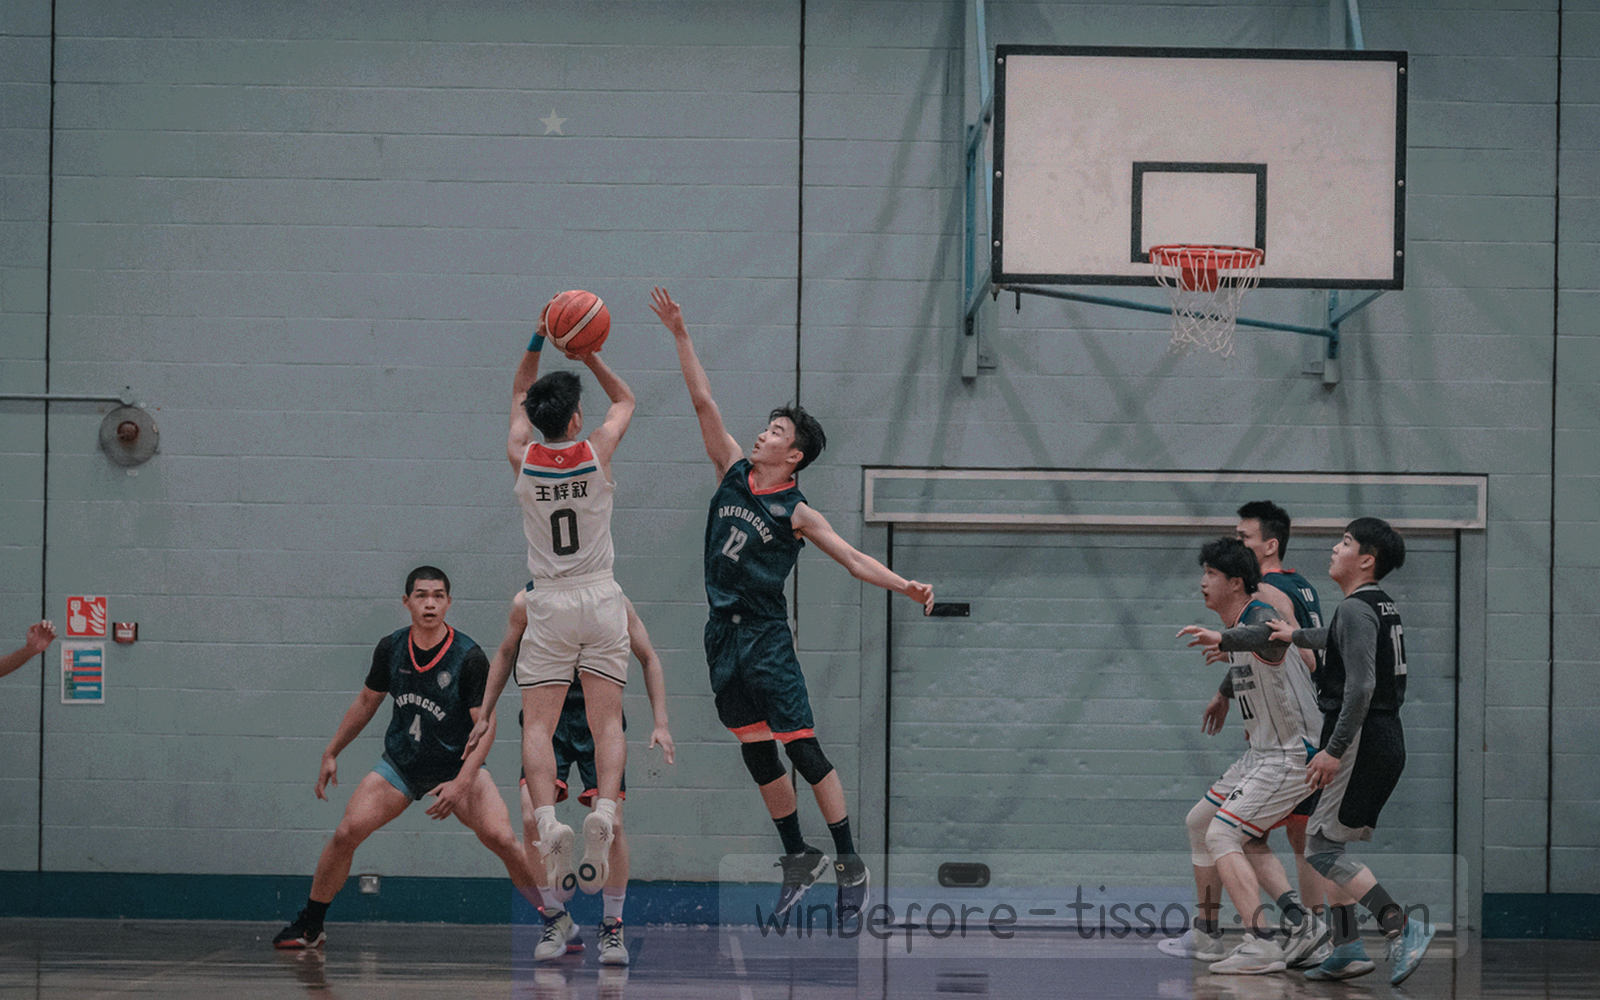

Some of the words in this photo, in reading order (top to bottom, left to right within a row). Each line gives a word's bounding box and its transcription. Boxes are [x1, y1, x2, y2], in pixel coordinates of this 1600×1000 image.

[550, 508, 580, 556] 0
[718, 505, 774, 544] OXFORDCSSA
[721, 525, 748, 562] 12
[408, 713, 422, 742] 4
